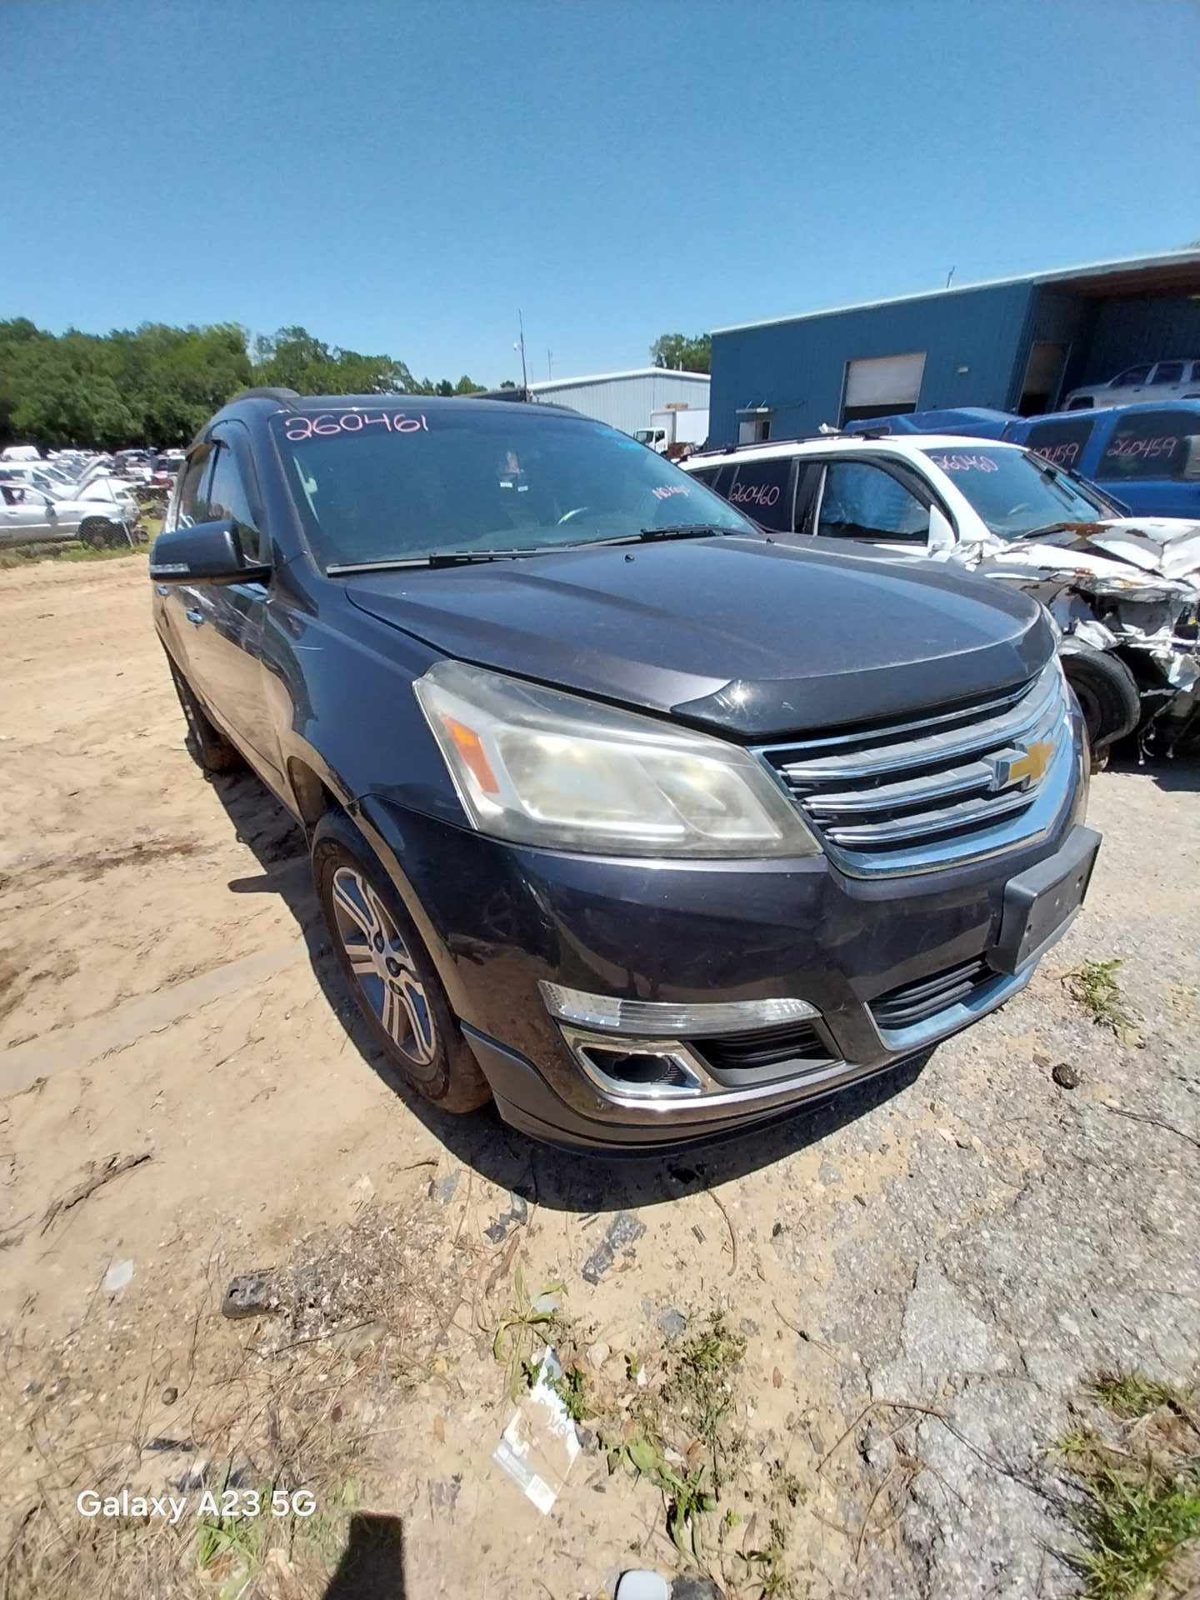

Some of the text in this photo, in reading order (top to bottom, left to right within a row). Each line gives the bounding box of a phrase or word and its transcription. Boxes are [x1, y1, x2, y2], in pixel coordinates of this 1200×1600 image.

[285, 413, 429, 441] 260461
[1034, 442, 1080, 465] 0459
[1107, 436, 1179, 458] 260459
[729, 482, 780, 506] 260460
